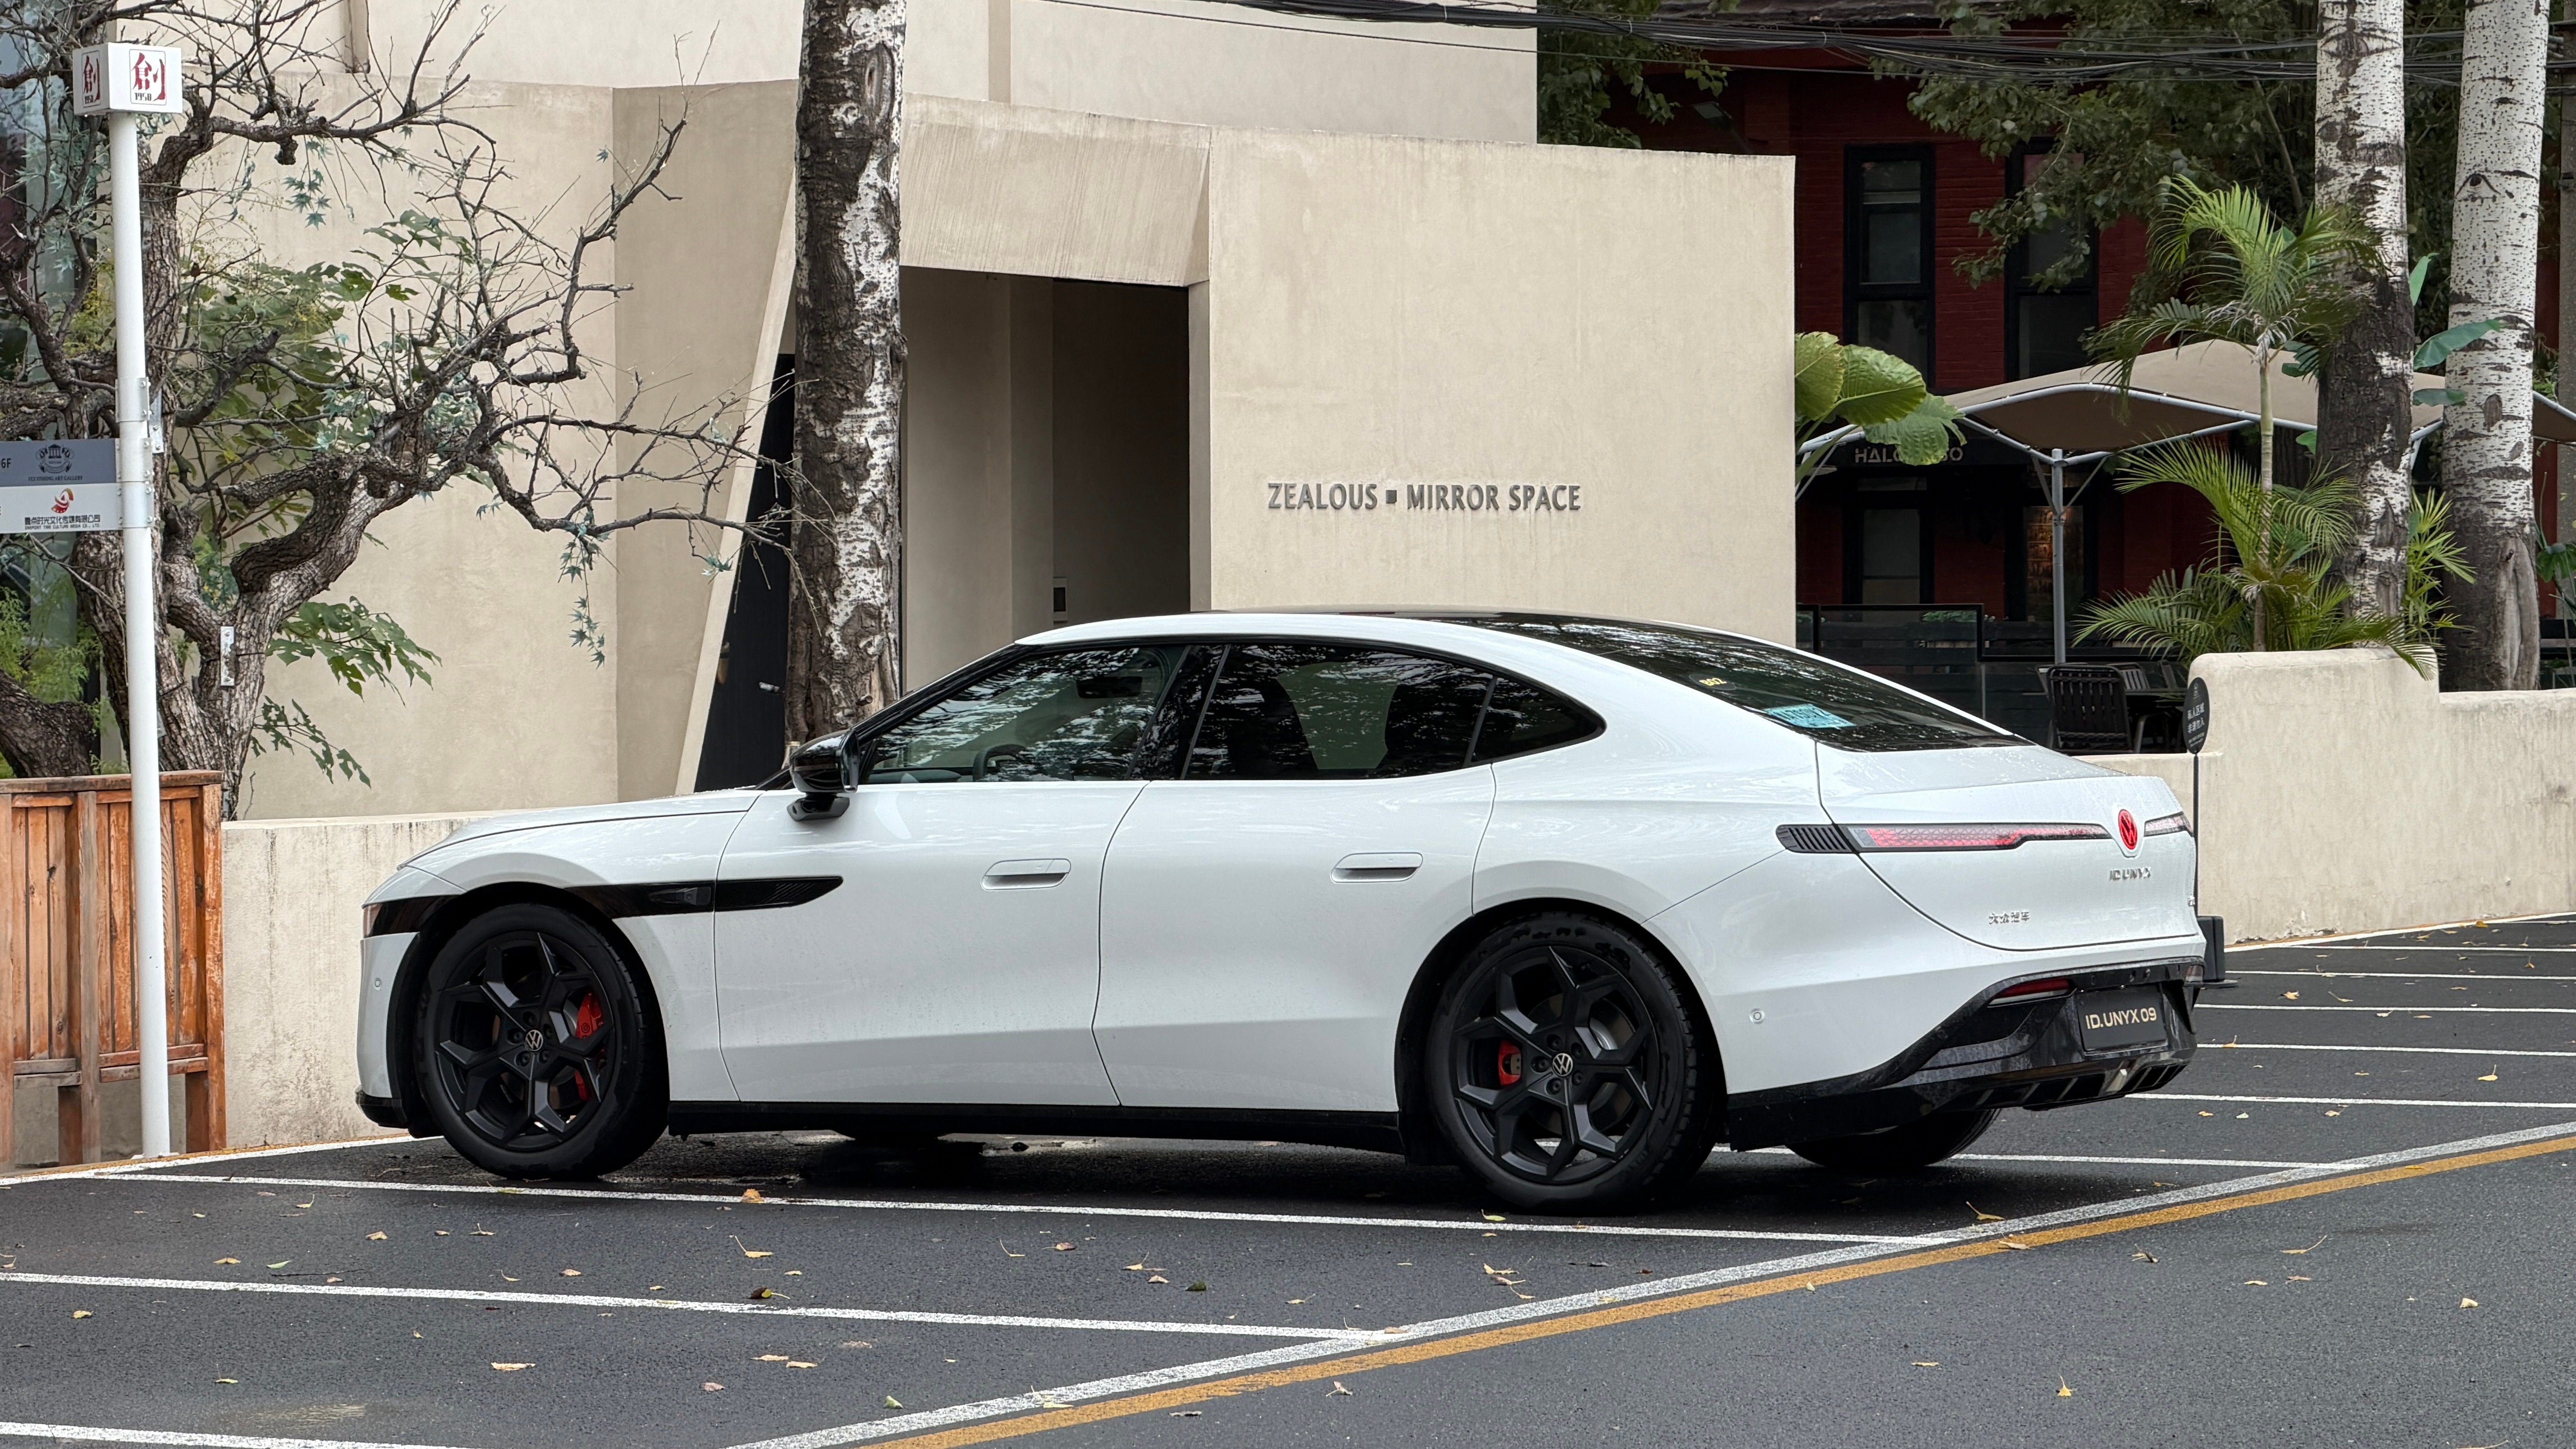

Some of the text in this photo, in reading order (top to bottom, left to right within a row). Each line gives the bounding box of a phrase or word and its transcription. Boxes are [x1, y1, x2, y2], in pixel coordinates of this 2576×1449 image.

[0, 458, 11, 468] 6F
[1268, 483, 1581, 511] ZEALOUS MIRROR SPACE
[2085, 1007, 2157, 1029] ID.UNYX 09
